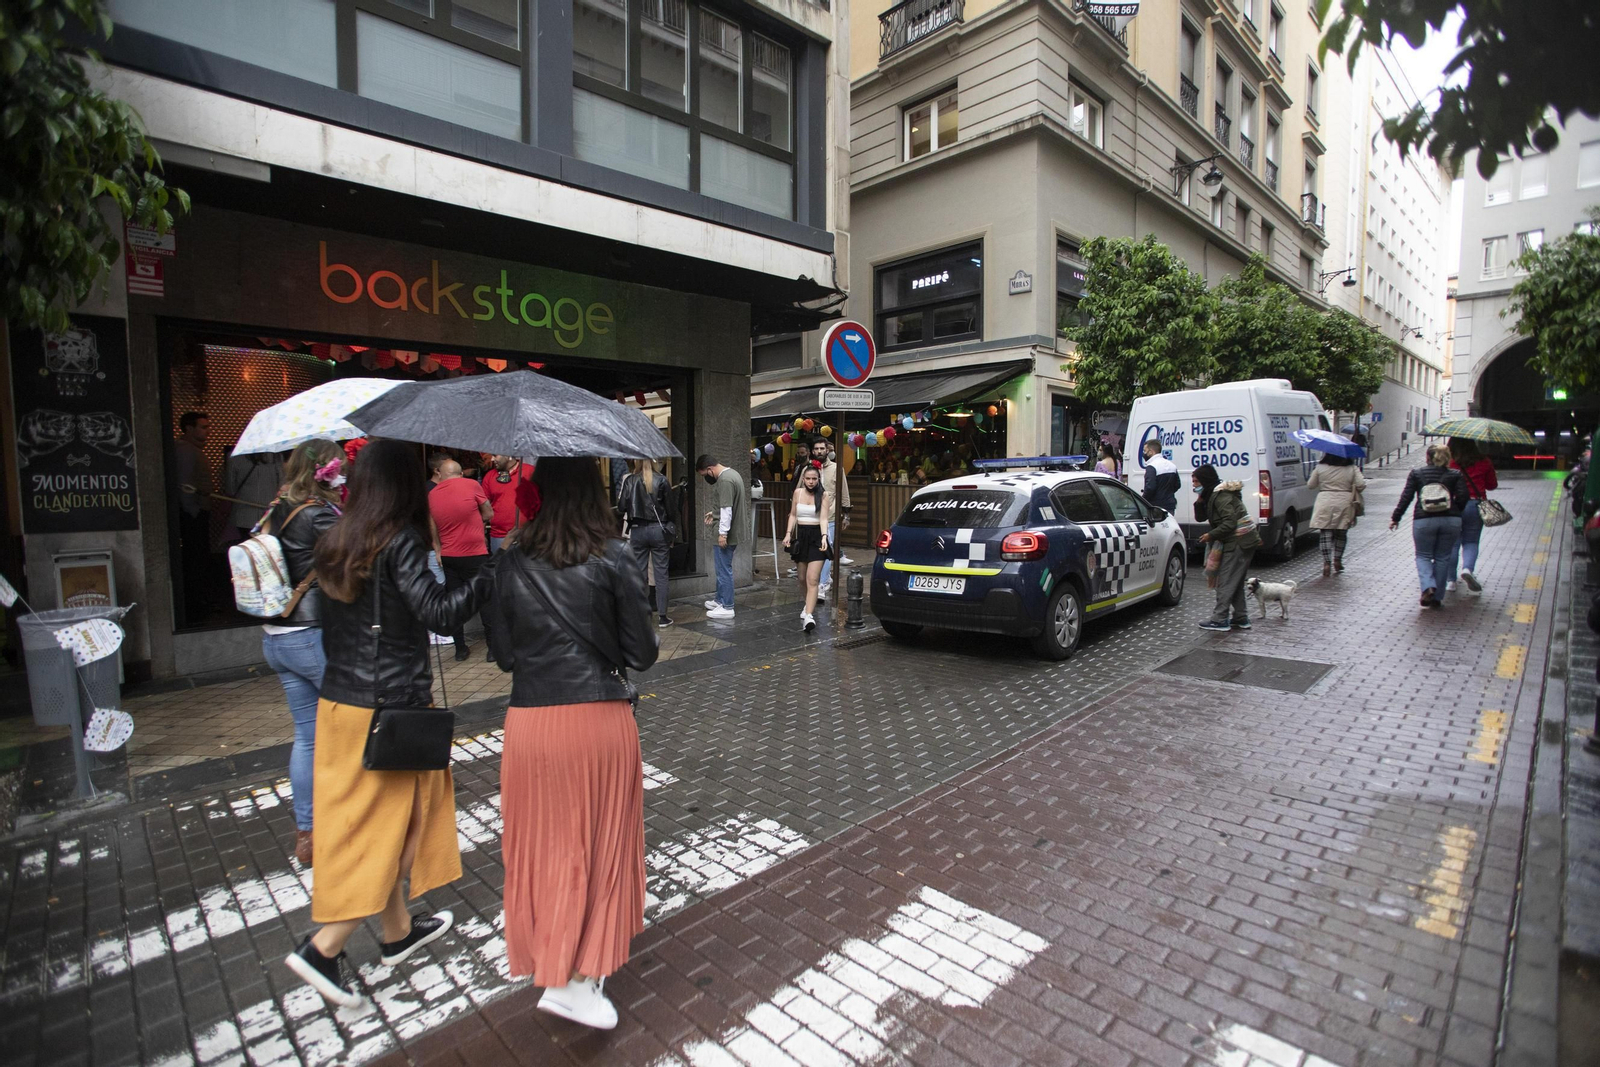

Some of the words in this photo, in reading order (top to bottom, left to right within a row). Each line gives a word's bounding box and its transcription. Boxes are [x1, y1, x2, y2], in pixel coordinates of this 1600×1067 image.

[1104, 5, 1120, 14] 565
[1121, 5, 1137, 14] 567
[131, 245, 175, 257] IGILANCIA
[319, 240, 614, 349] backstage
[1191, 419, 1243, 436] HIELOS
[1191, 437, 1227, 452] CERO
[1191, 452, 1250, 468] GRADOS
[32, 474, 129, 492] MOMENTOS
[33, 492, 134, 513] CLANDEXTINO
[912, 499, 957, 512] POLICÍA
[959, 500, 1003, 512] LOCAL
[1138, 559, 1155, 572] LOCAL
[914, 576, 939, 589] 0269
[942, 578, 963, 590] JYS
